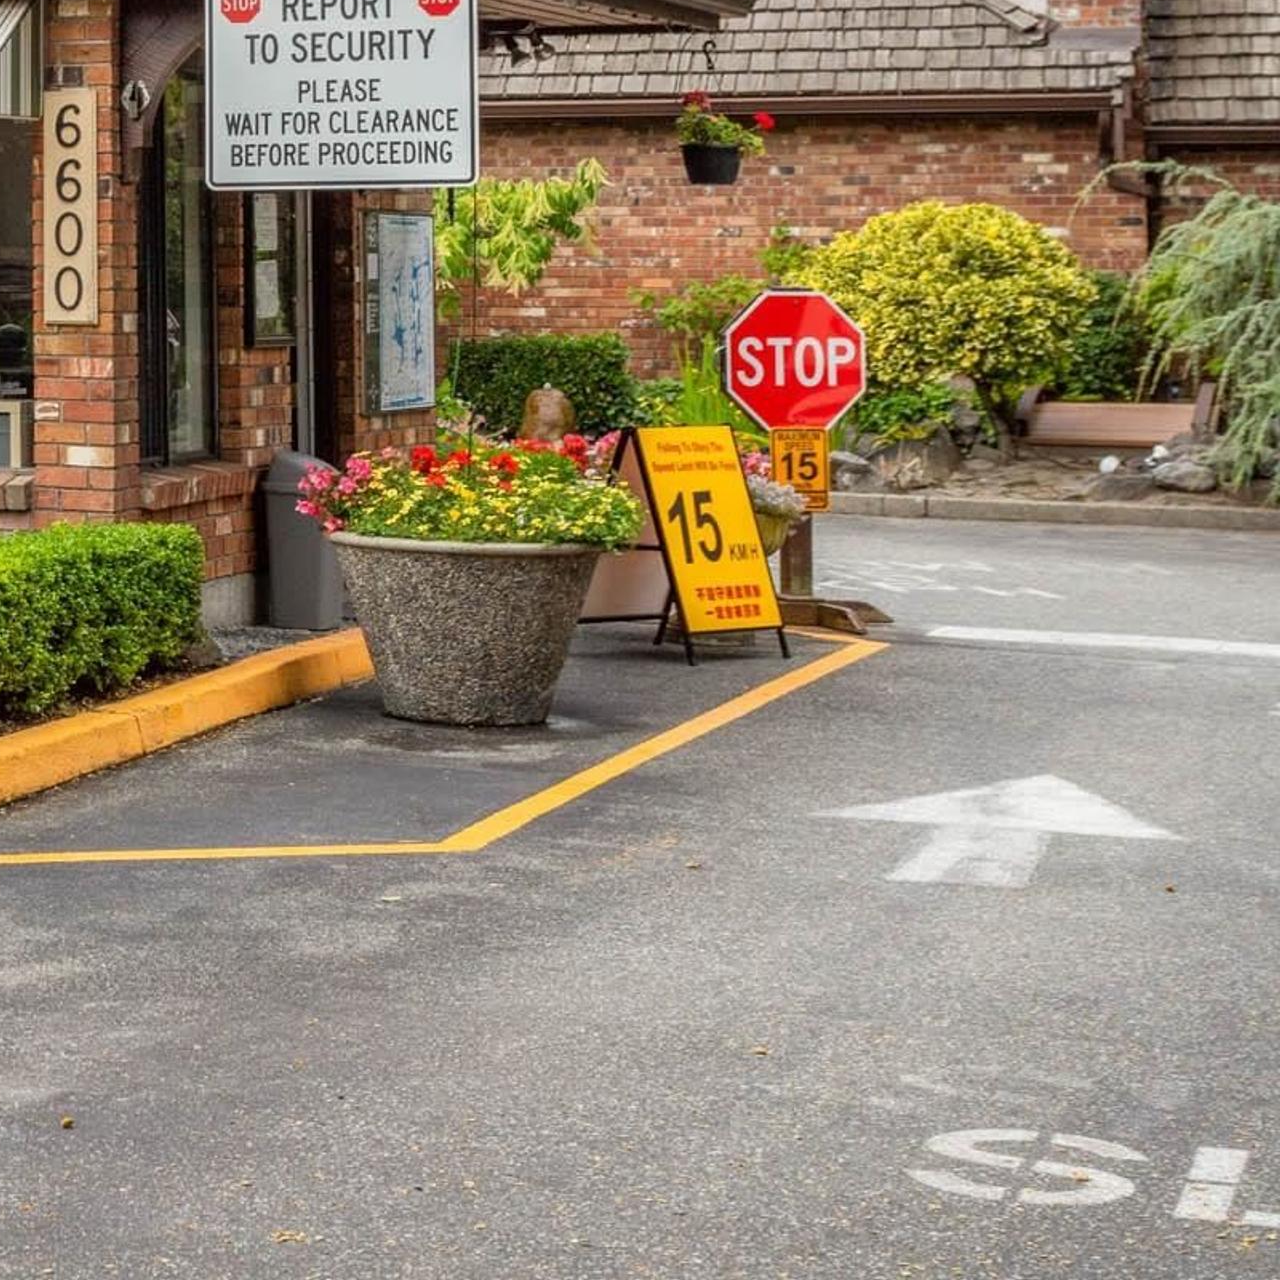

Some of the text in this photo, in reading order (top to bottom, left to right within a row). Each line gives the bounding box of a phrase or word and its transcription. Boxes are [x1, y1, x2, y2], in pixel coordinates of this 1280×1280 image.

[244, 28, 436, 65] TO SECURITY
[297, 78, 381, 104] PLEASE
[224, 108, 459, 137] WAIT FOR CLEARANCE
[230, 140, 453, 167] BEFORE PROCEEDING
[55, 104, 83, 311] 6600
[736, 336, 856, 388] STOP
[780, 451, 819, 481] 15
[668, 490, 723, 564] 15
